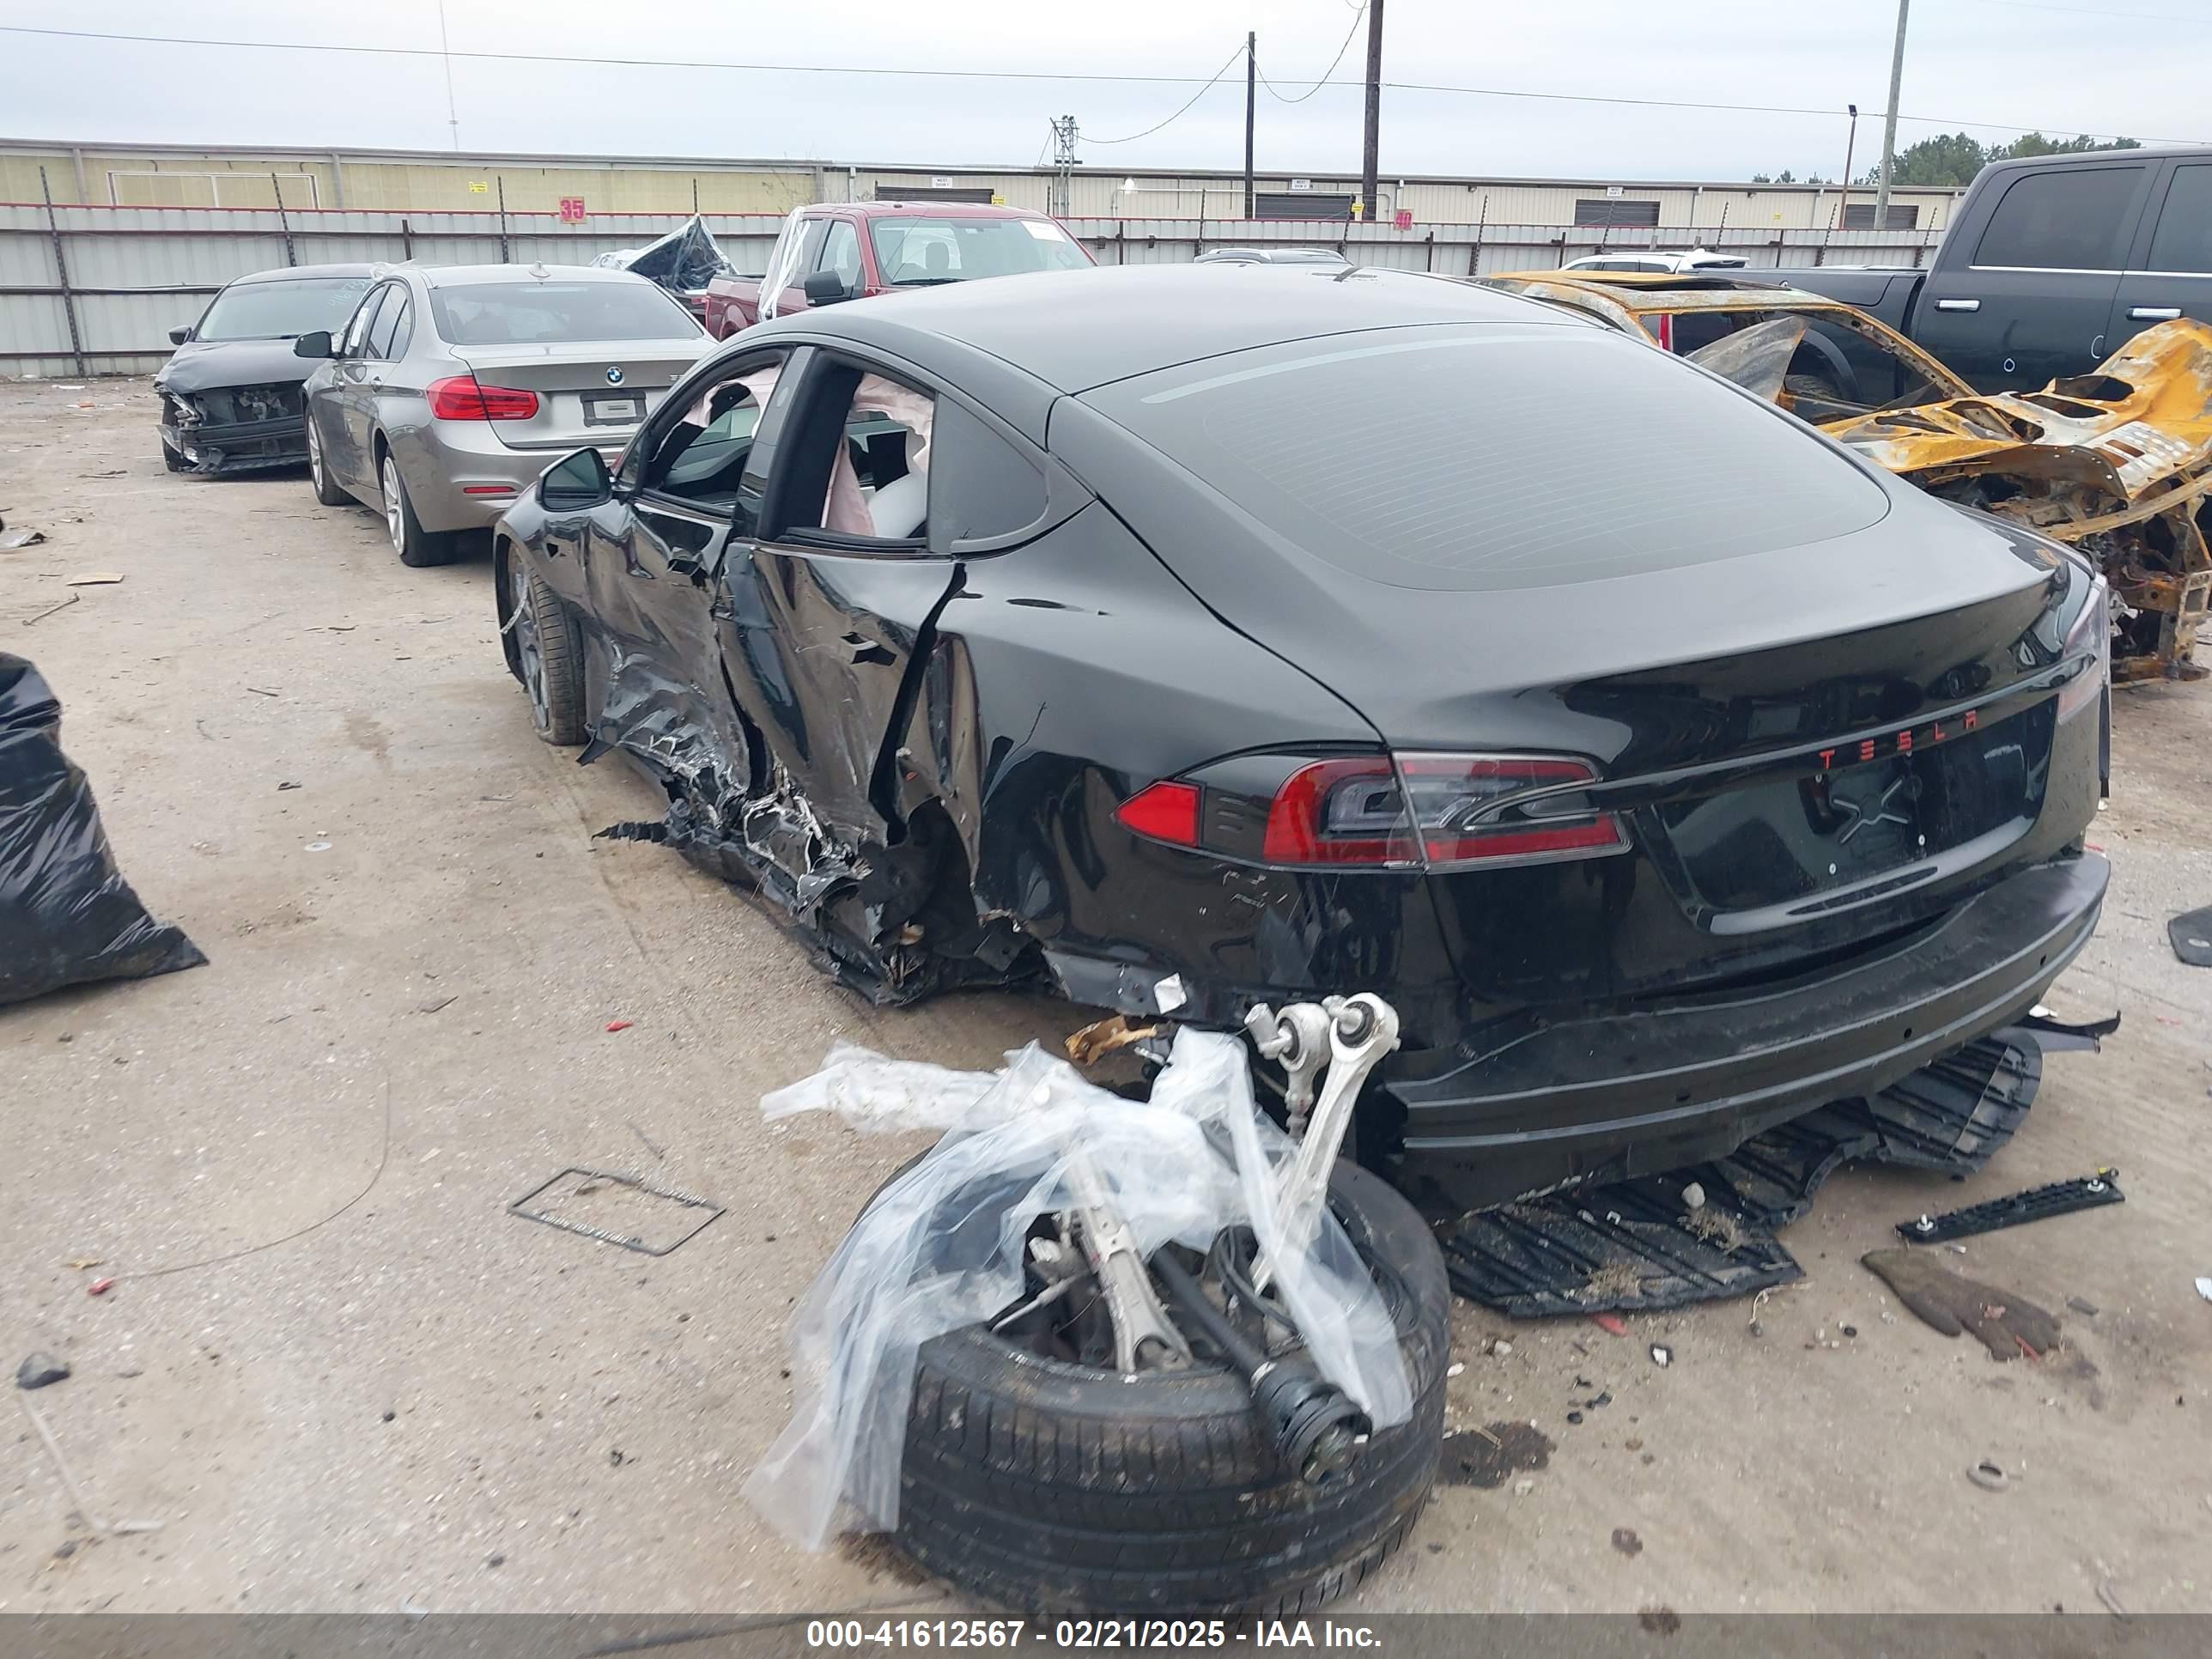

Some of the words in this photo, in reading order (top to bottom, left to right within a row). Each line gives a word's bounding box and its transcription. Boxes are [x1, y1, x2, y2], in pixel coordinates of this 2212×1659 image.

[560, 199, 585, 221] 35
[1395, 212, 1413, 230] 40
[1819, 709, 1977, 770] TESLA
